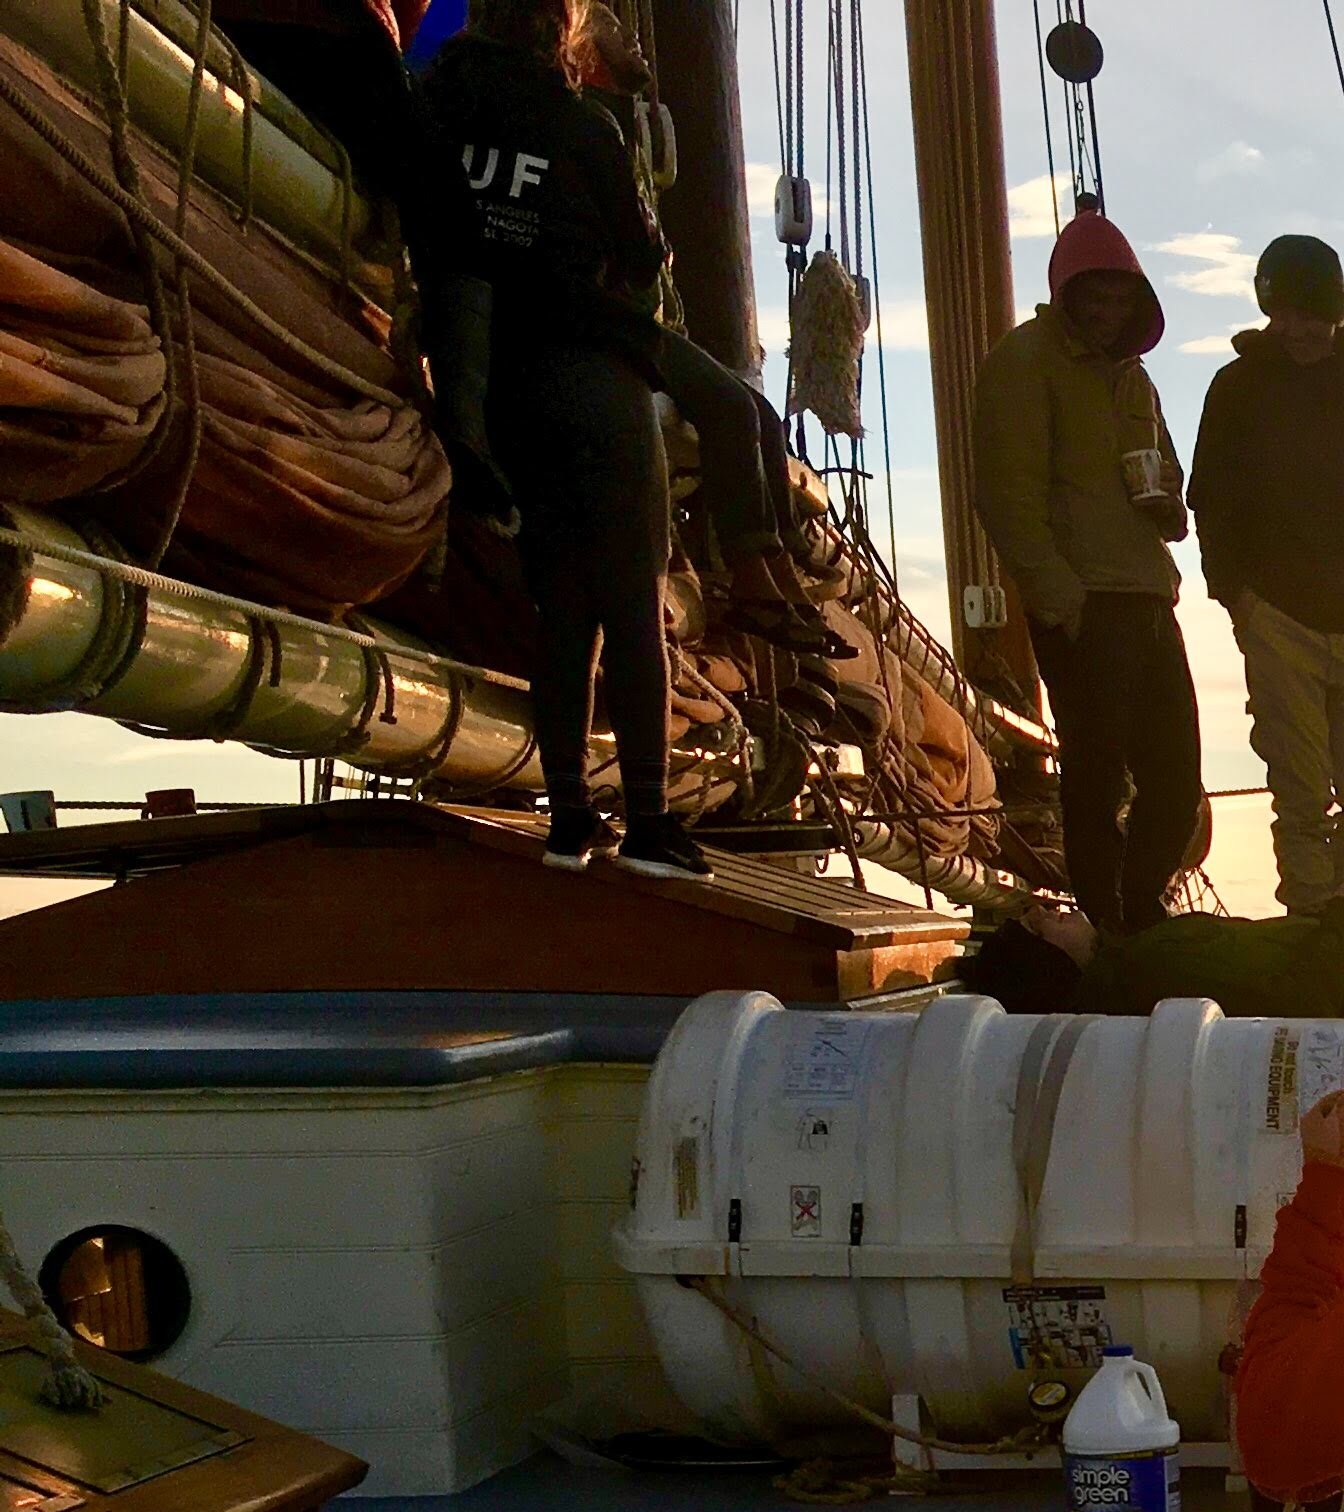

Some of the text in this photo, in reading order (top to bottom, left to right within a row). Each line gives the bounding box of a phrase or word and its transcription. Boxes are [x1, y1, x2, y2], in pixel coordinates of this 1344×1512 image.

[1266, 1065, 1281, 1130] EQUIPMENT
[1072, 1463, 1131, 1488] simple
[1073, 1485, 1129, 1506] green
